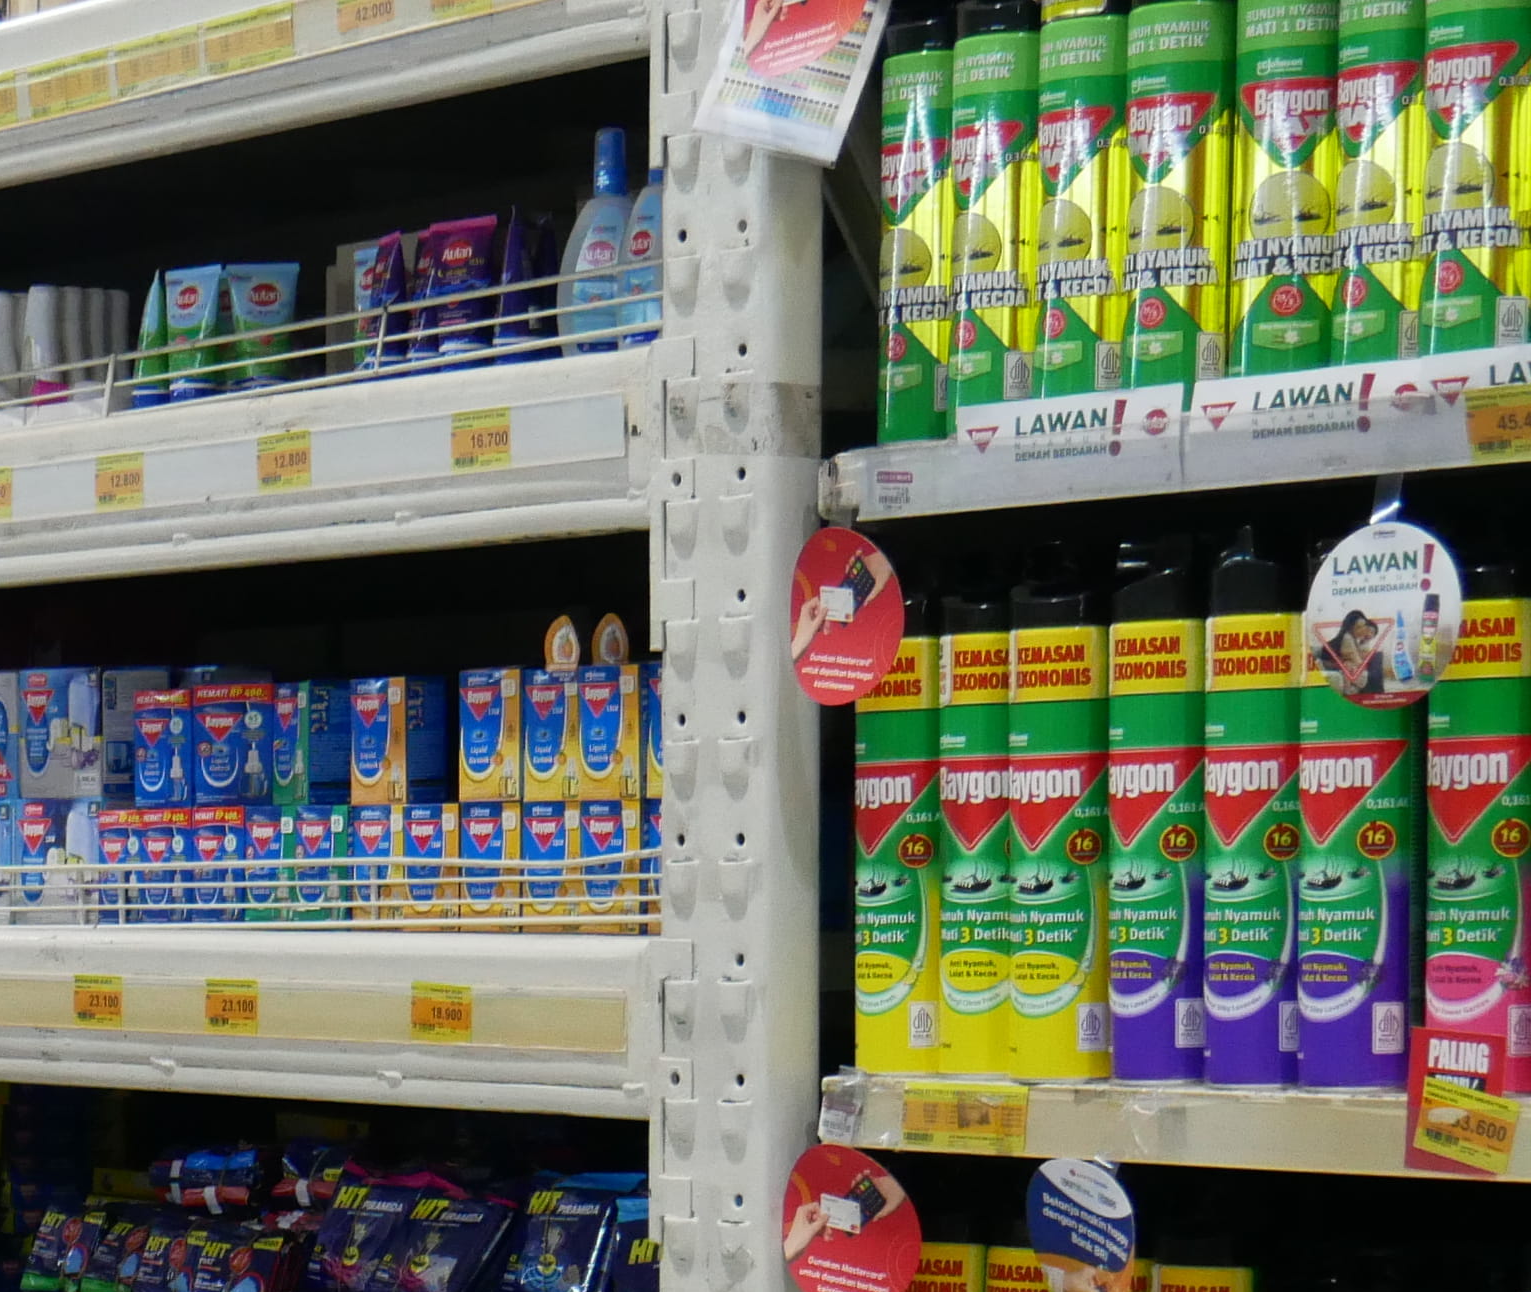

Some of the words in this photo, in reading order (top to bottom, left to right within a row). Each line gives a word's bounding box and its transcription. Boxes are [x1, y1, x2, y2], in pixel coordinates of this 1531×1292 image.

[1154, 19, 1211, 35] NYAMUK
[1246, 22, 1278, 38] MATI
[1426, 54, 1492, 86] Baygon
[1254, 88, 1330, 115] Baygon
[1456, 227, 1520, 248] KECOA
[441, 246, 473, 263] Autan
[1160, 262, 1218, 287] KECOA
[1060, 276, 1118, 298] KECOA
[970, 289, 1029, 310] KECOA
[1497, 412, 1531, 430] 45.4
[470, 430, 509, 449] 16.700
[1252, 427, 1292, 440] DEMAM
[1294, 422, 1355, 435] BERDARAH
[274, 451, 308, 469] 12.800
[1015, 449, 1051, 462] DEMAM
[1053, 445, 1107, 458] BERDARAH
[110, 471, 140, 488] 12.800
[1332, 586, 1366, 596] DEMAM
[1368, 583, 1418, 594] BERDARAH
[1114, 636, 1181, 657] KEMASAN
[1213, 630, 1285, 652] KEMASAN
[954, 647, 1009, 667] KEMASA
[1213, 654, 1291, 676] EKONOMIS
[1114, 659, 1187, 682] EKONOMIS
[867, 911, 915, 926] Nyamuk
[1030, 911, 1083, 927] Nyamuk
[1123, 908, 1177, 924] Nyamuk
[862, 929, 871, 945] 3
[1024, 929, 1034, 946] 3
[88, 994, 119, 1009] 23.100
[221, 999, 254, 1014] 23.100
[1428, 1038, 1489, 1074] PALING
[1452, 1115, 1507, 1142] 3.600
[333, 1187, 370, 1209] HIT
[361, 1200, 404, 1213] PIRAMIDA
[529, 1191, 564, 1215] HIT
[557, 1203, 599, 1216] PIRAMIDA
[410, 1199, 451, 1220] HIT
[42, 1211, 66, 1228] HIT
[110, 1222, 133, 1236] HIT
[145, 1236, 170, 1253] HIT
[203, 1241, 232, 1259] HIT
